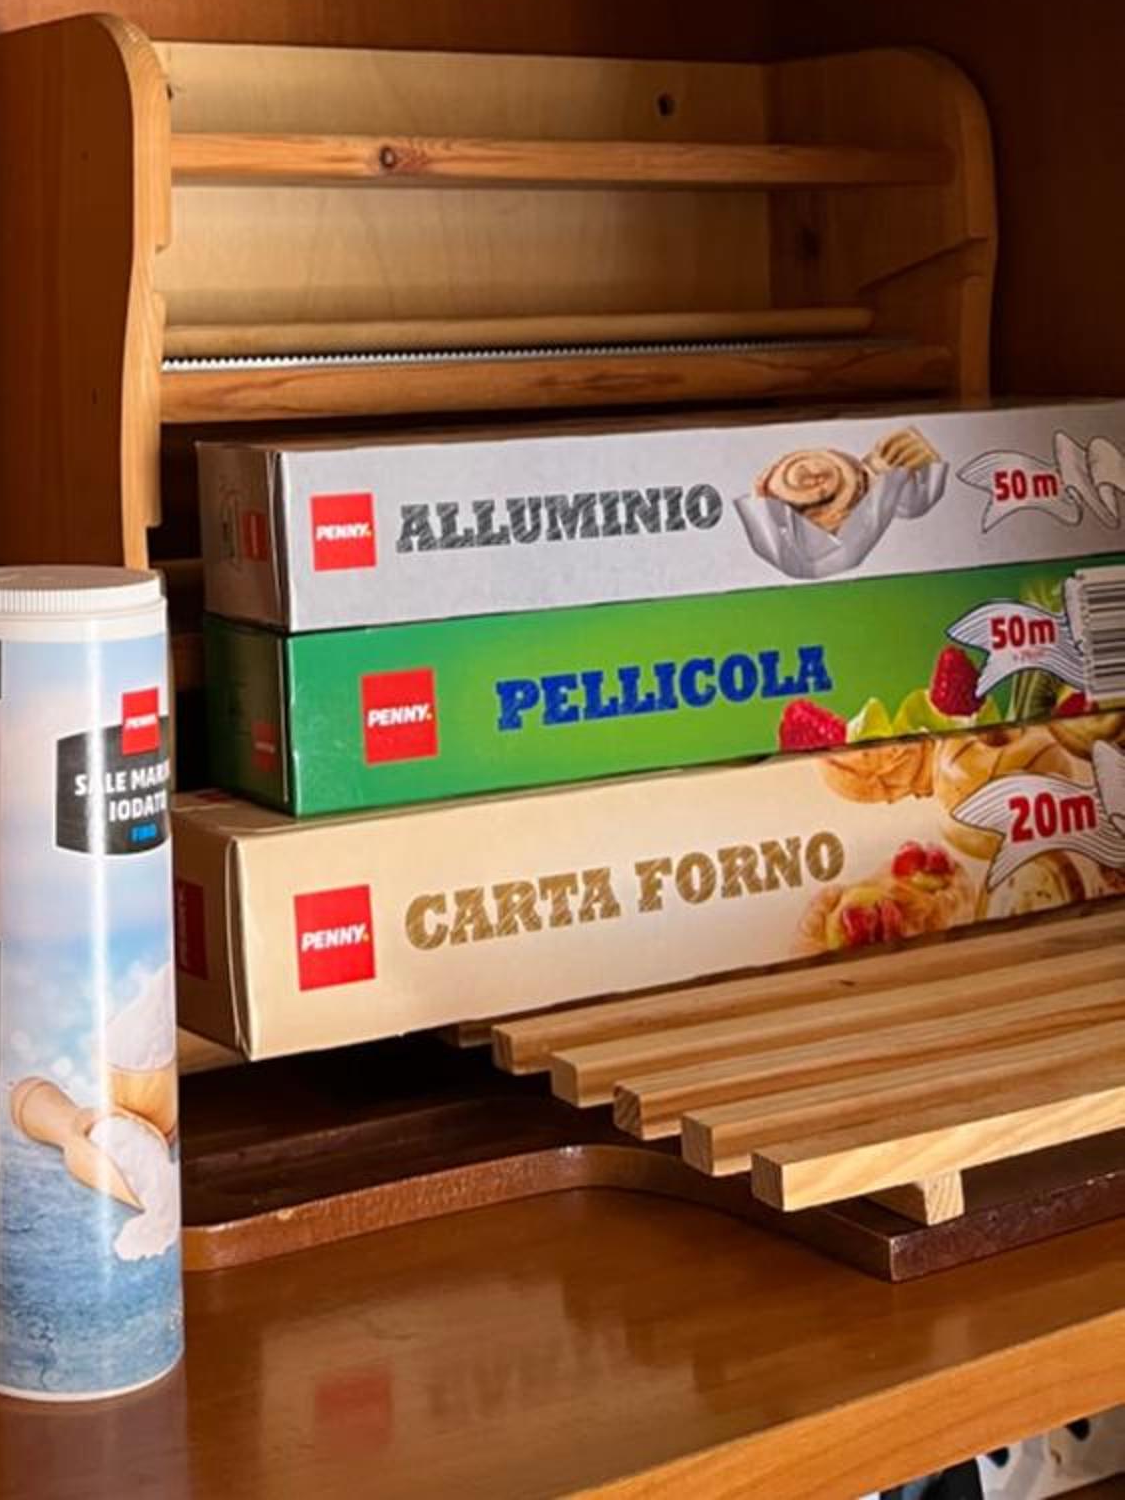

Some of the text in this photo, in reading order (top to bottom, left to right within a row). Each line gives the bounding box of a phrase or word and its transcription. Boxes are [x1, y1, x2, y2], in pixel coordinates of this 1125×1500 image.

[395, 482, 724, 554] ALLUMINIO
[993, 468, 1059, 502] 50 m
[494, 644, 834, 733] PELLICOLA
[1007, 791, 1097, 843] 20m
[404, 865, 623, 951] CARTA
[633, 829, 846, 912] FORNO
